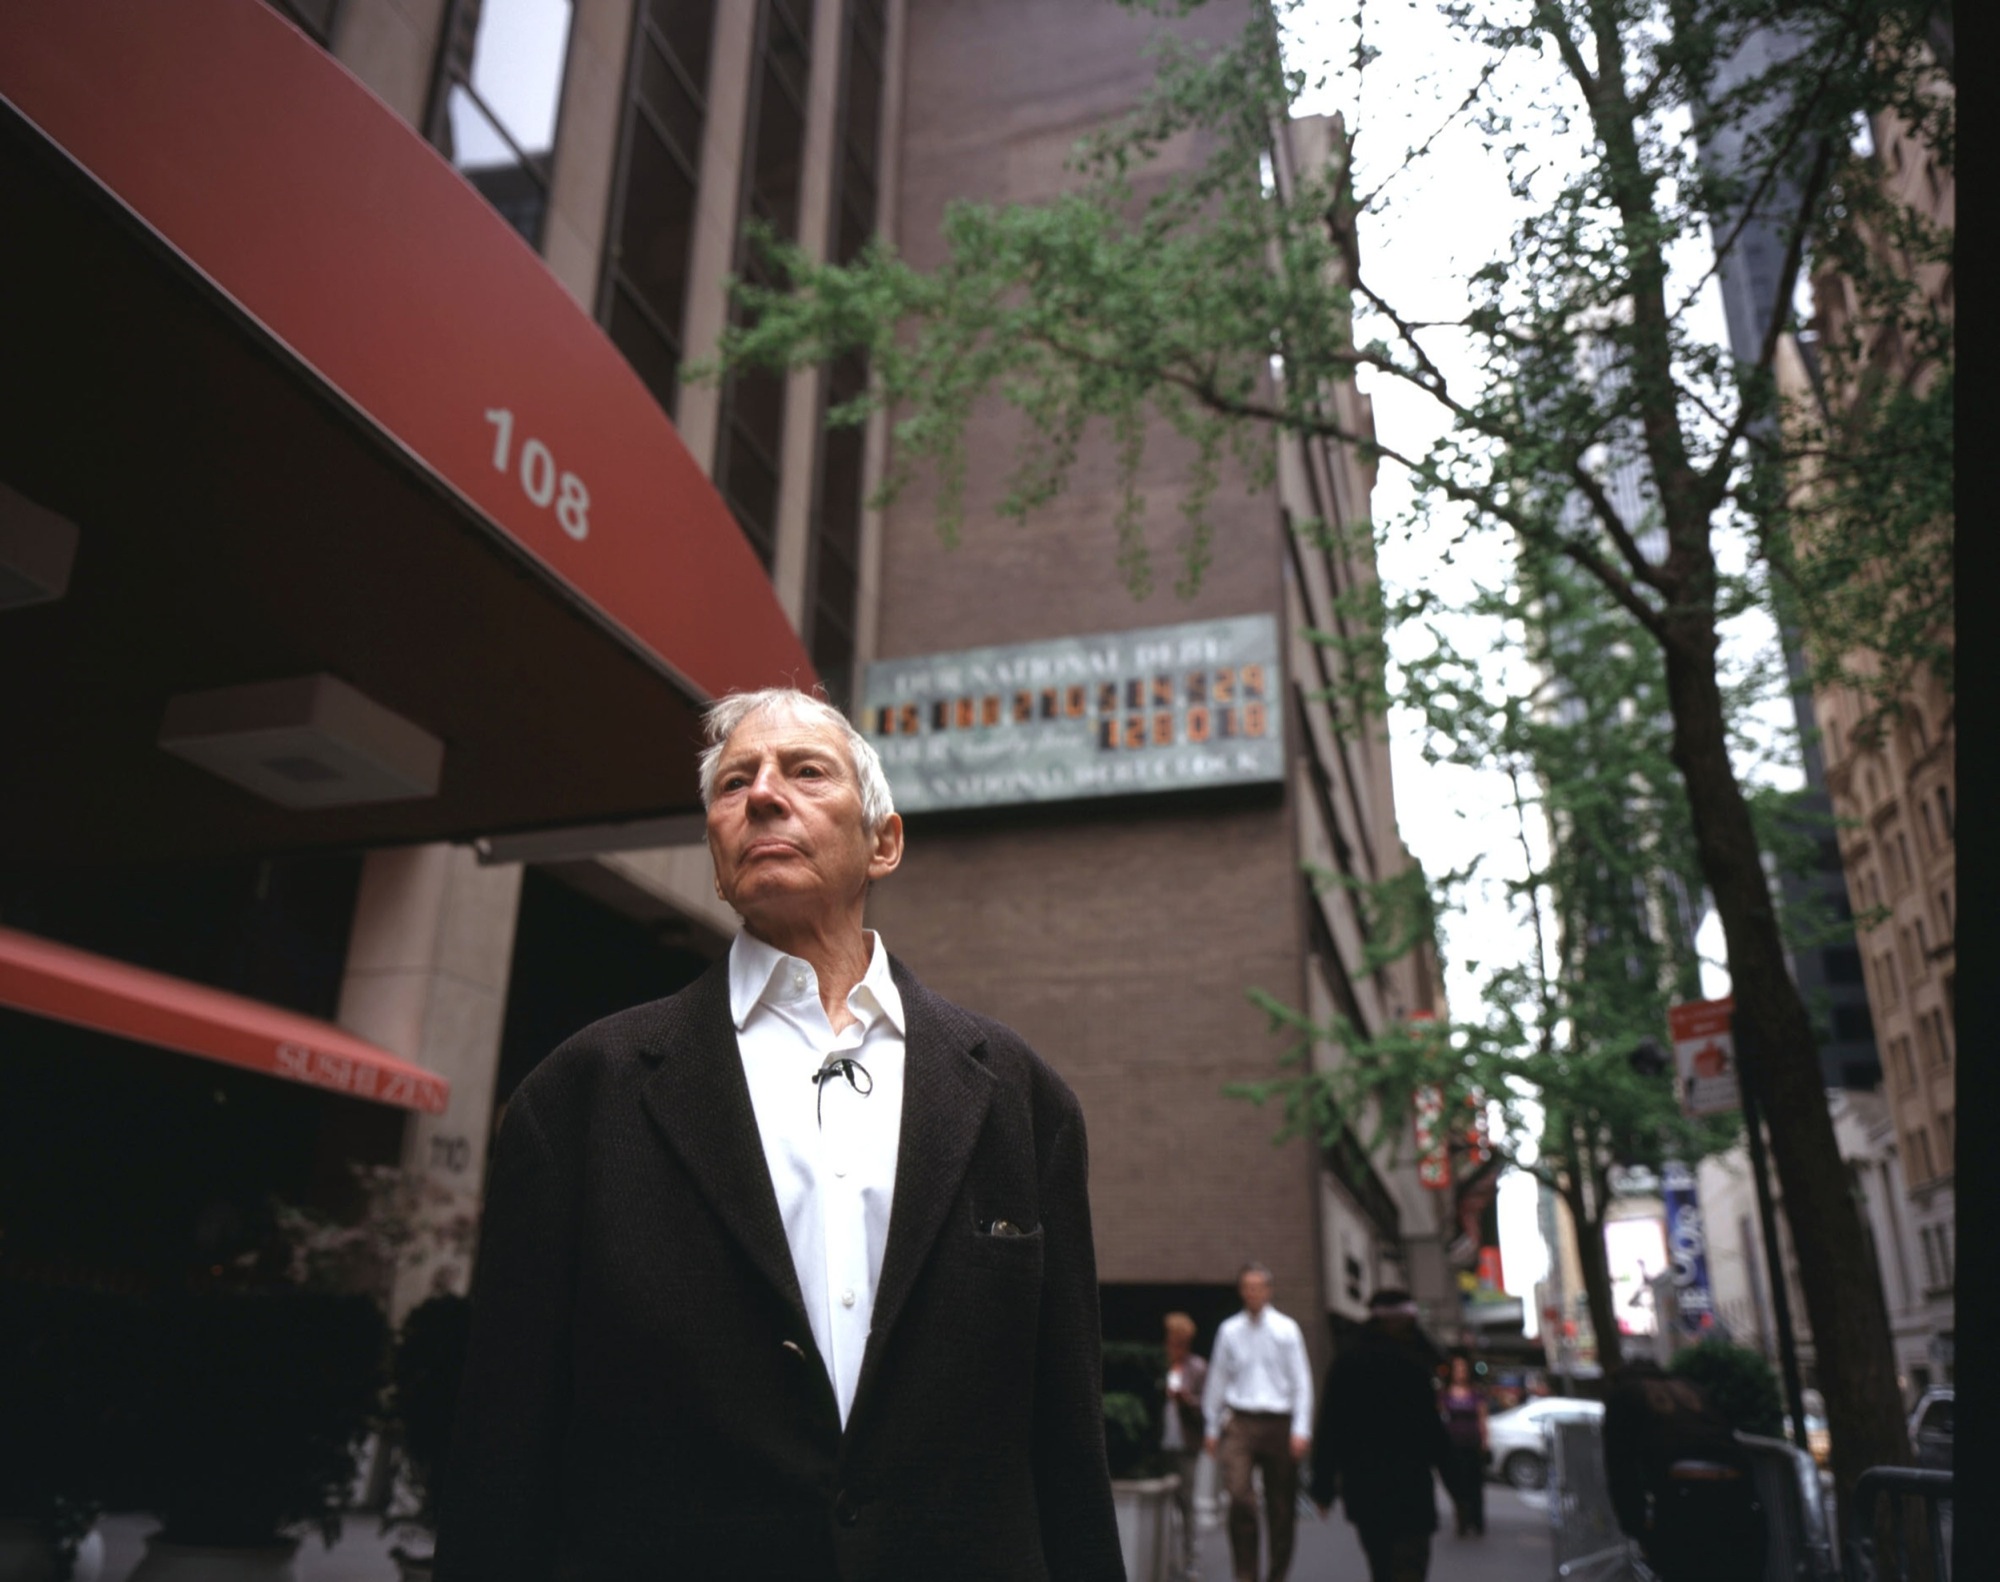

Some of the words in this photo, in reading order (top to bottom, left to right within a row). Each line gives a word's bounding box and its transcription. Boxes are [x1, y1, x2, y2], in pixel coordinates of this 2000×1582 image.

[484, 407, 590, 543] 108
[968, 650, 1120, 688] NATIONAL
[275, 1040, 379, 1098] SUSHI
